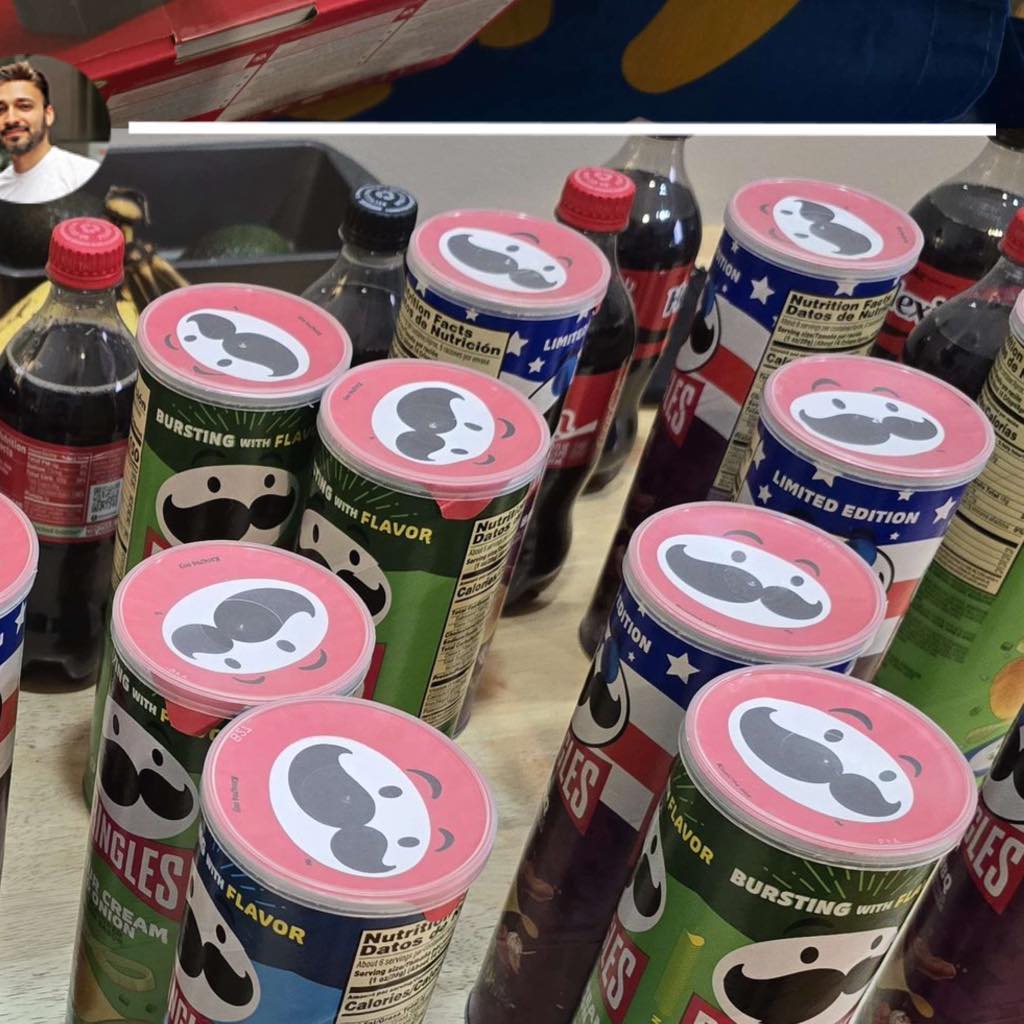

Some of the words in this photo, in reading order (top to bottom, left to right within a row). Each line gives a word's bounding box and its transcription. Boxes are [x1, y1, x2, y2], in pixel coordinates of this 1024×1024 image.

[786, 304, 831, 322] Datos
[836, 309, 854, 322] de
[790, 293, 859, 311] Nutrition
[430, 323, 501, 356] Nutrición
[433, 313, 473, 338] Facts
[156, 407, 236, 448] BURSTING
[240, 437, 271, 449] WITH
[772, 470, 839, 514] LIMITED
[841, 503, 920, 526] EDITION
[333, 494, 359, 521] WITH
[360, 511, 434, 545] FLAVOR
[473, 524, 511, 545] Datos
[132, 687, 157, 717] WITH
[667, 794, 715, 865] FLAVOR
[729, 868, 853, 917] BURSTING
[857, 900, 894, 916] WITH
[102, 890, 168, 944] CREAM
[225, 883, 306, 945] FLAVOR
[360, 936, 424, 957] Datos
[354, 967, 386, 978] Serving
